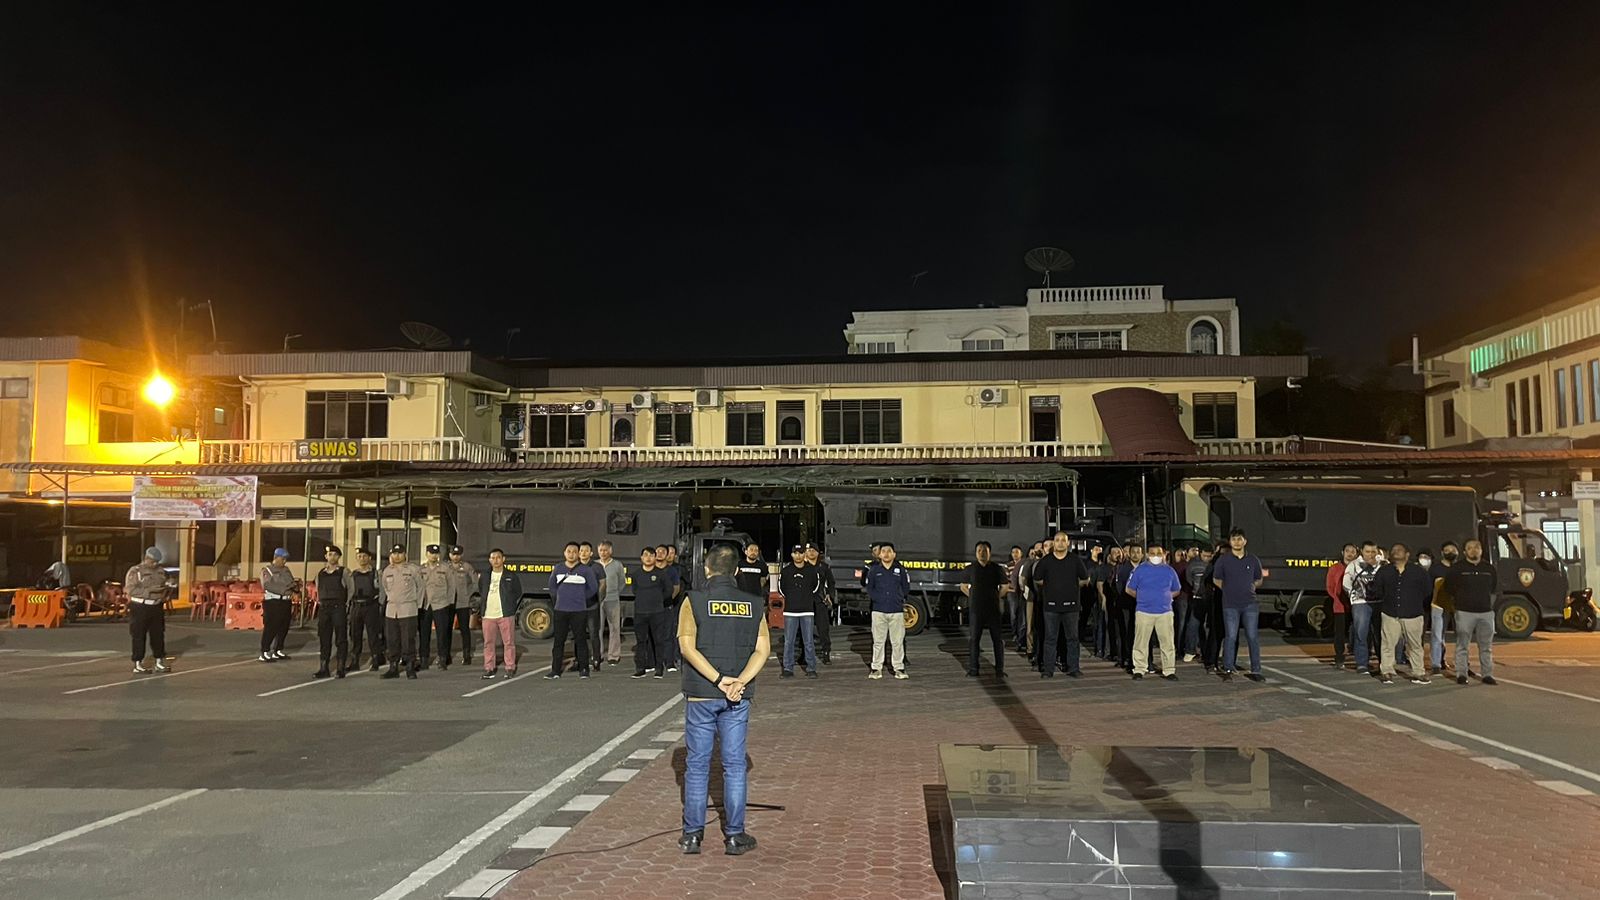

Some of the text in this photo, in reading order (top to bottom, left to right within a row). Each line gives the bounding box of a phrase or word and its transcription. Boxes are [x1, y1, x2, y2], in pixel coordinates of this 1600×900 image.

[310, 441, 358, 457] SIWAS
[1285, 559, 1310, 567] TIM
[711, 602, 750, 616] POLISI
